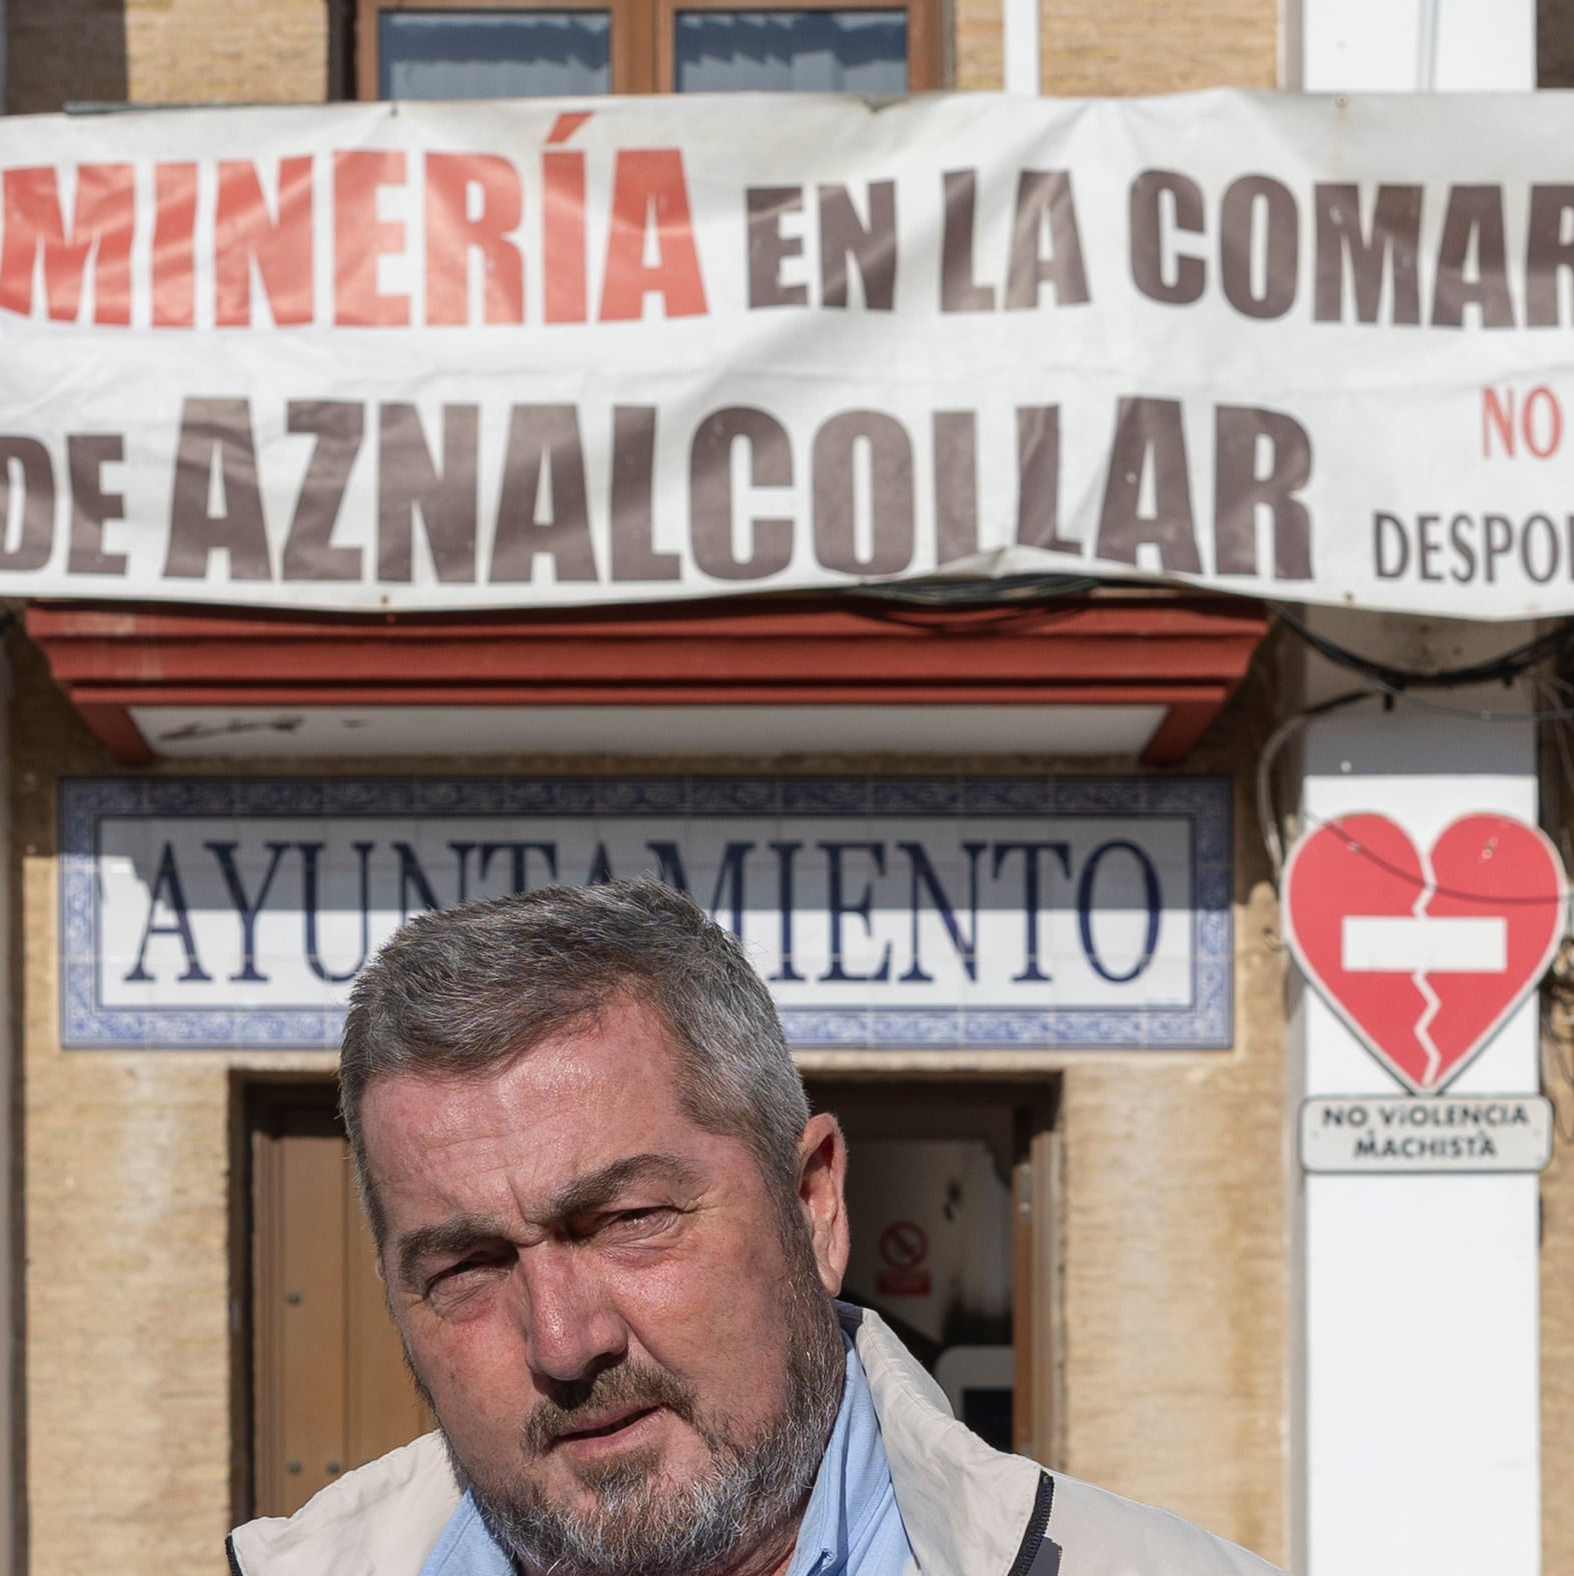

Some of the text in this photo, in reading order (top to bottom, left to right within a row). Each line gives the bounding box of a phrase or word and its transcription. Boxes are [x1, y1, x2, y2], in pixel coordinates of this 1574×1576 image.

[743, 180, 900, 313] EN
[938, 167, 1091, 313] LA
[1483, 385, 1563, 460] NO
[161, 396, 1315, 583] AZNALCOLLAR
[125, 840, 1165, 984] AYUNTMIENTO
[1322, 1103, 1529, 1127] NO VIOLENCIA
[1353, 1136, 1498, 1158] MACHISTA
